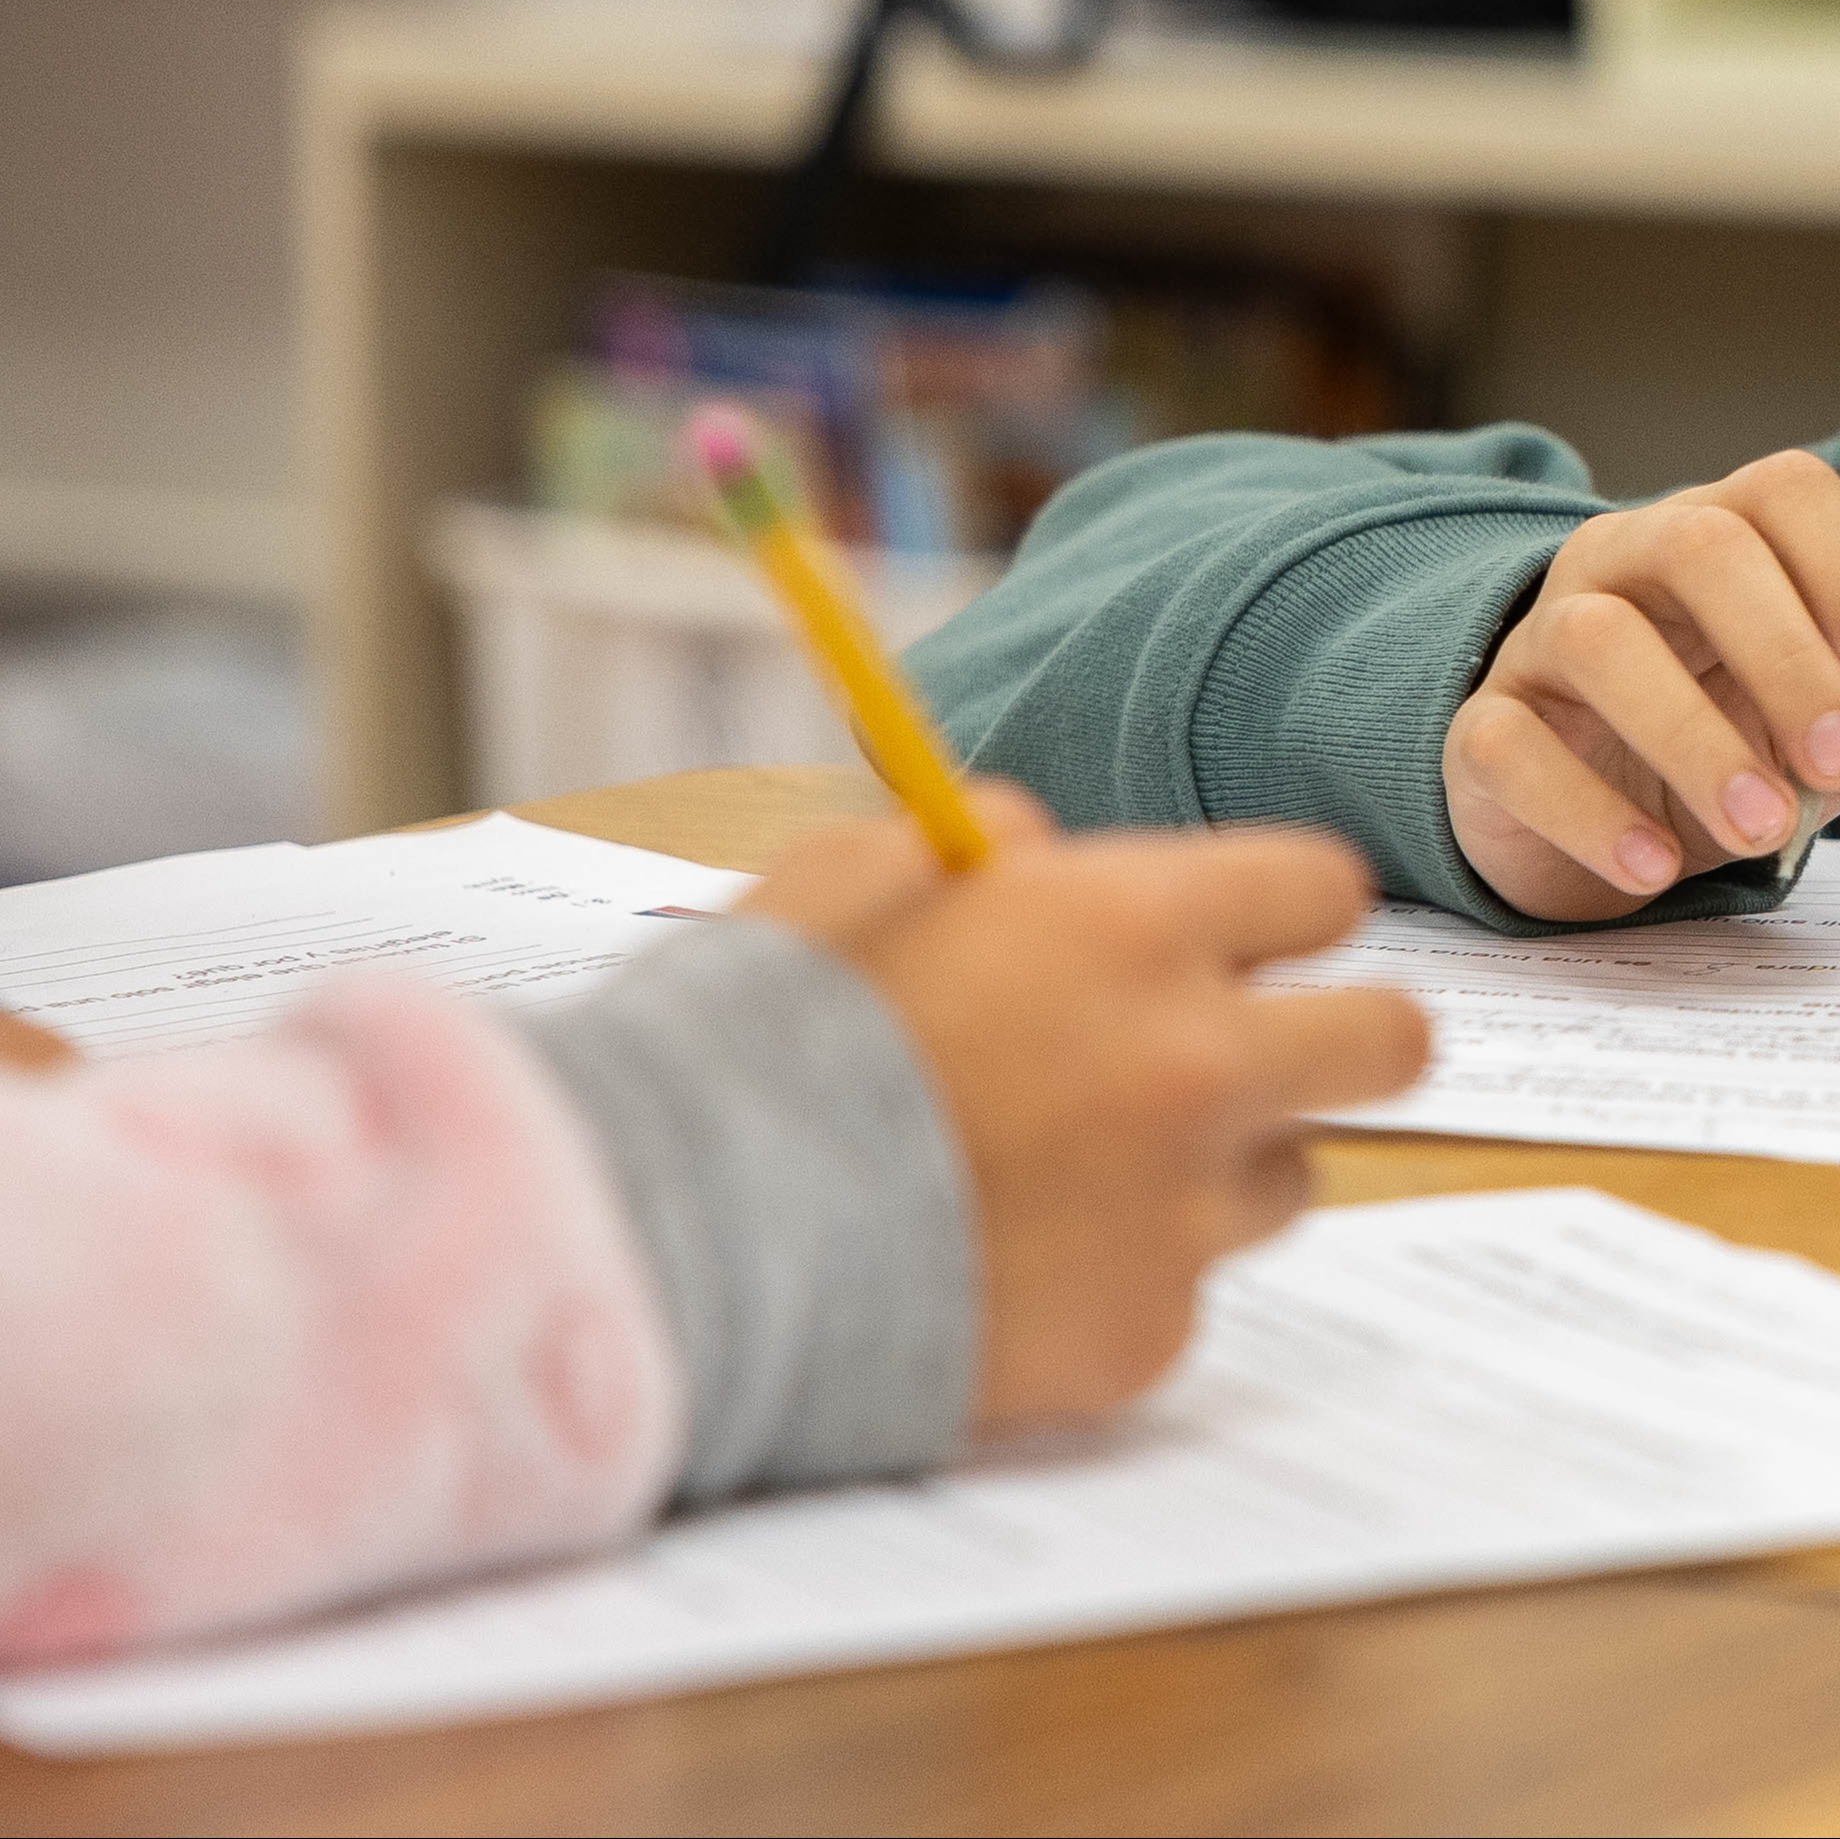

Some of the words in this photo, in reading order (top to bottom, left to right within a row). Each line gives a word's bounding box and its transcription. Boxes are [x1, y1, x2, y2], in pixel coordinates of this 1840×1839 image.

[1429, 949, 1532, 961] buena
[1542, 956, 1603, 965] una
[253, 956, 302, 967] por
[268, 964, 327, 976] que
[45, 998, 106, 1009] una
